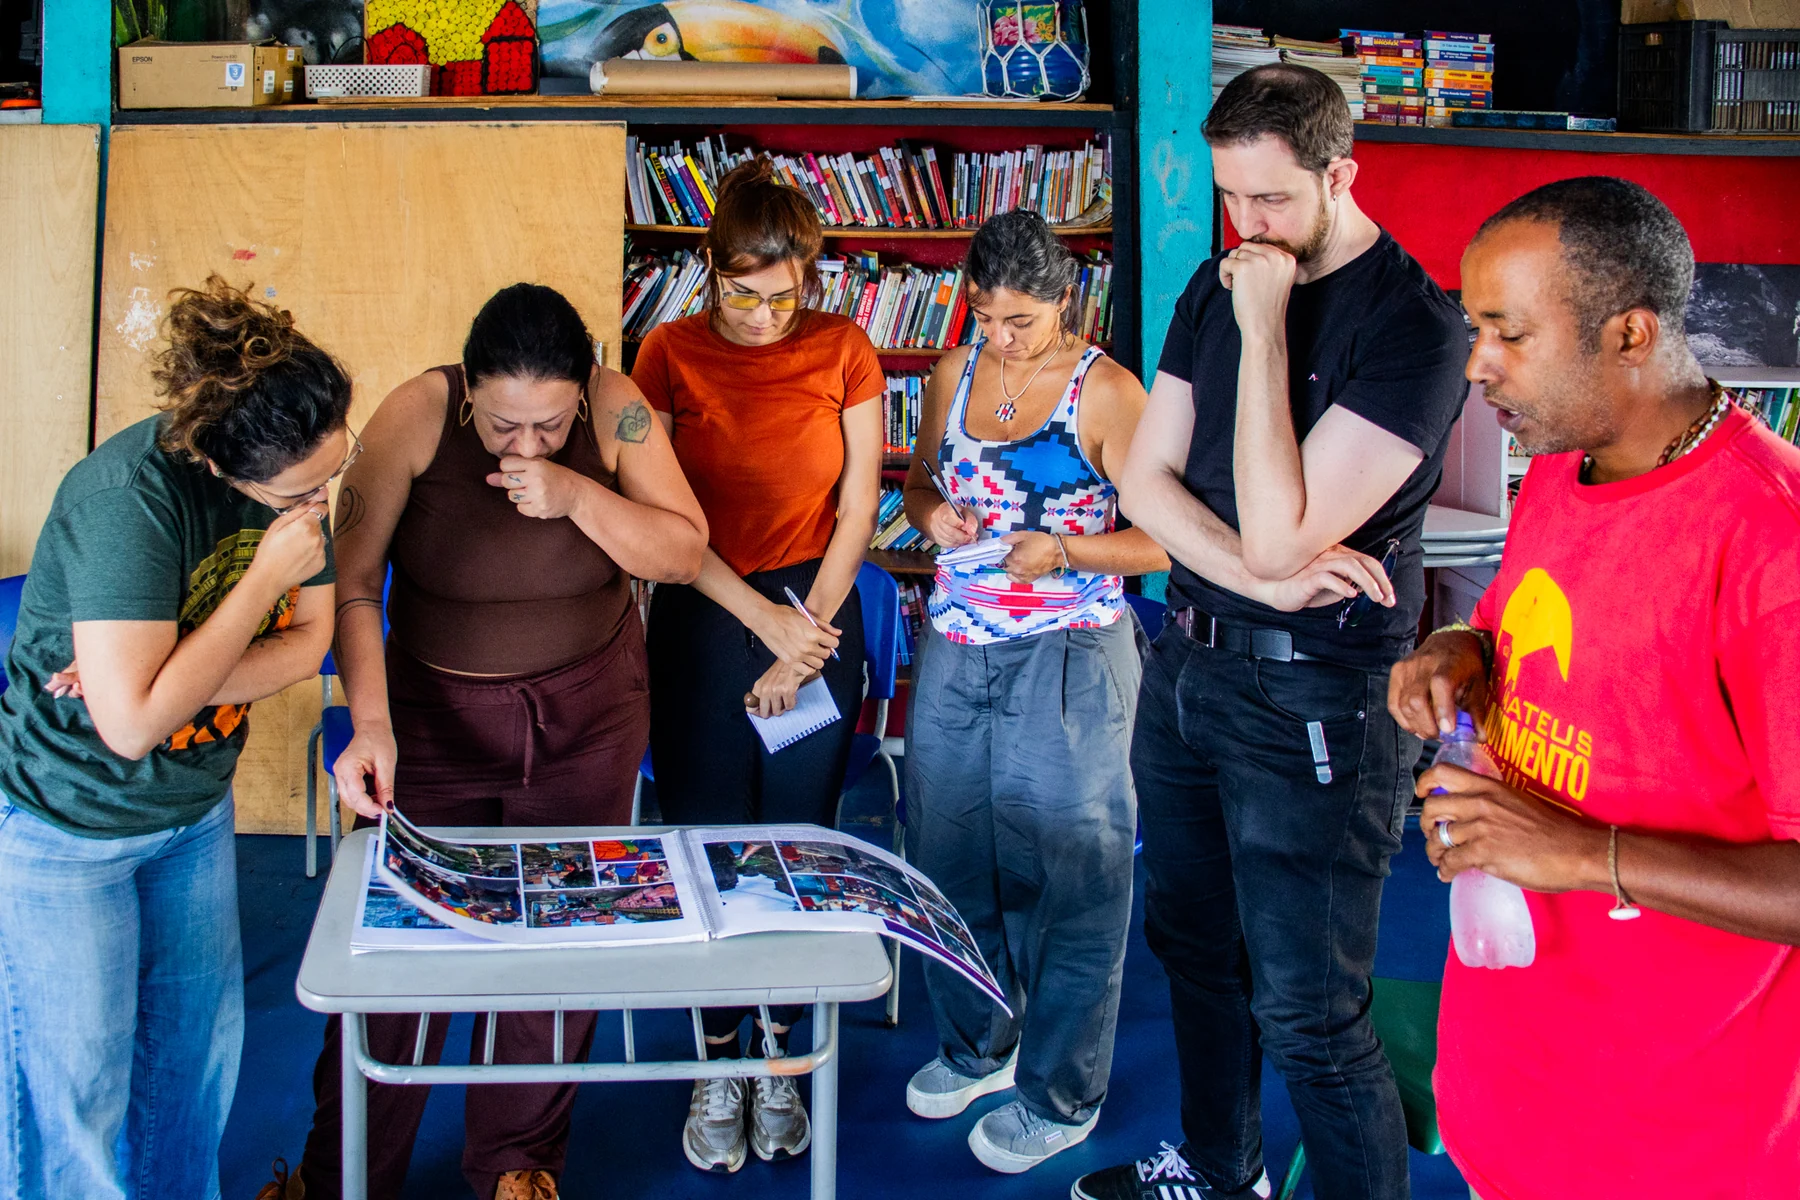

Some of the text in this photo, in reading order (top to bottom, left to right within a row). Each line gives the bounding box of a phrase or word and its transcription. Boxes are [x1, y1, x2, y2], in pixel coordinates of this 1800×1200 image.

[232, 68, 239, 76] 3
[1484, 702, 1590, 801] OVIMENTO
[1500, 763, 1527, 791] 2007
